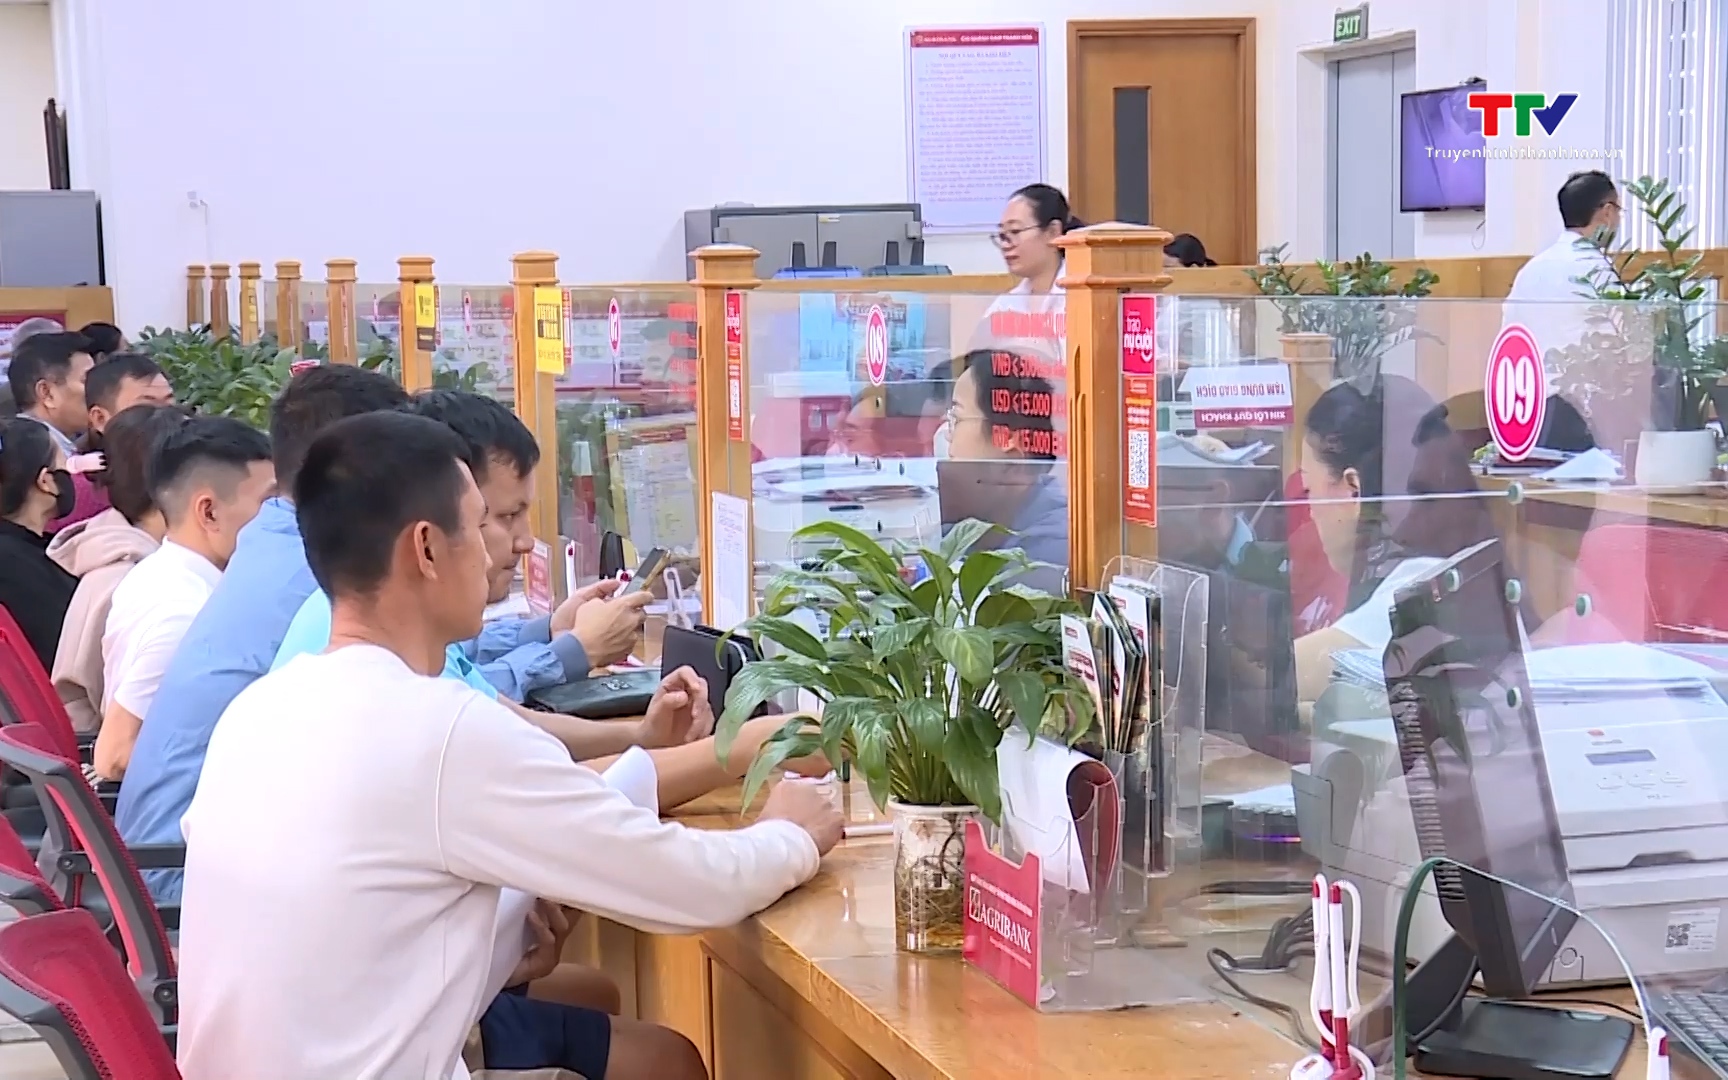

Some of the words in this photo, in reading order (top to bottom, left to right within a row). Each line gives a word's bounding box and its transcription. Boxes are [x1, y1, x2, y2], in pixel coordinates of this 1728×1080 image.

[1336, 15, 1361, 37] EXIT
[869, 324, 884, 364] 08
[991, 388, 1010, 412] USD
[1020, 392, 1050, 416] 15.000
[1495, 355, 1536, 425] 09
[981, 903, 1032, 954] AGRIBANK
